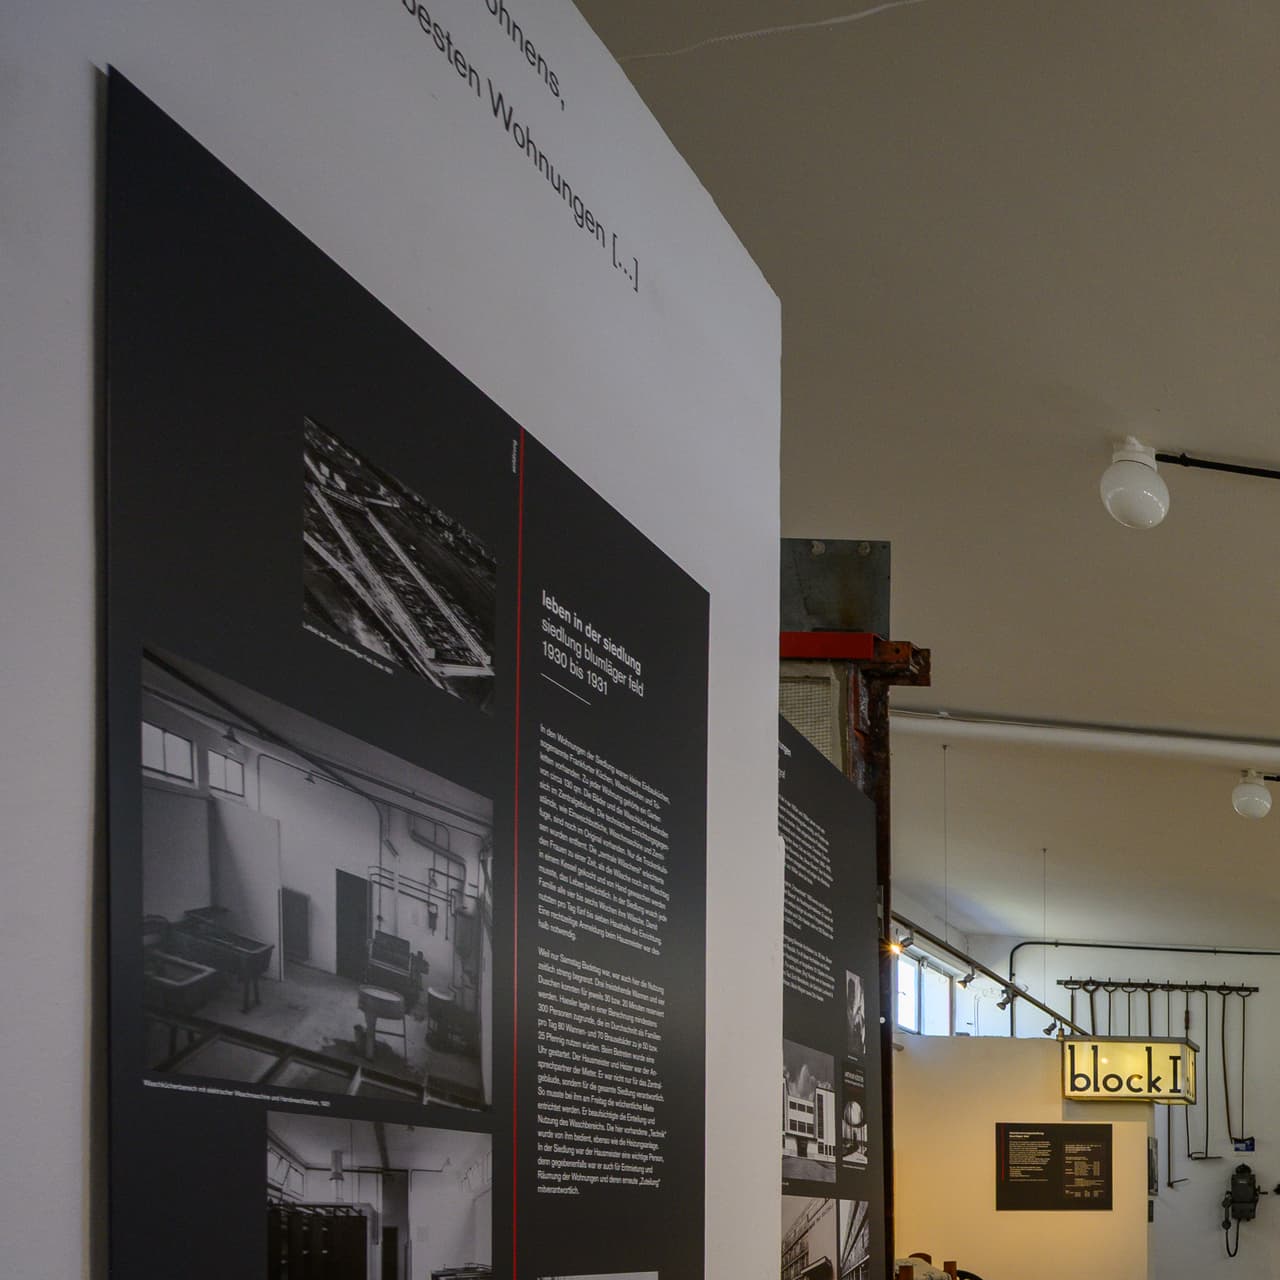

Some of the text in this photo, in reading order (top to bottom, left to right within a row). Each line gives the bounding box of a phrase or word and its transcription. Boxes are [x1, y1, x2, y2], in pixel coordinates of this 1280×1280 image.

[488, 78, 605, 248] Wohnungen
[541, 617, 644, 698] siedlung blumläger feld
[542, 589, 641, 676] leben in der siedlung
[542, 640, 608, 695] 1930 bis 1931
[1068, 1044, 1162, 1093] block
